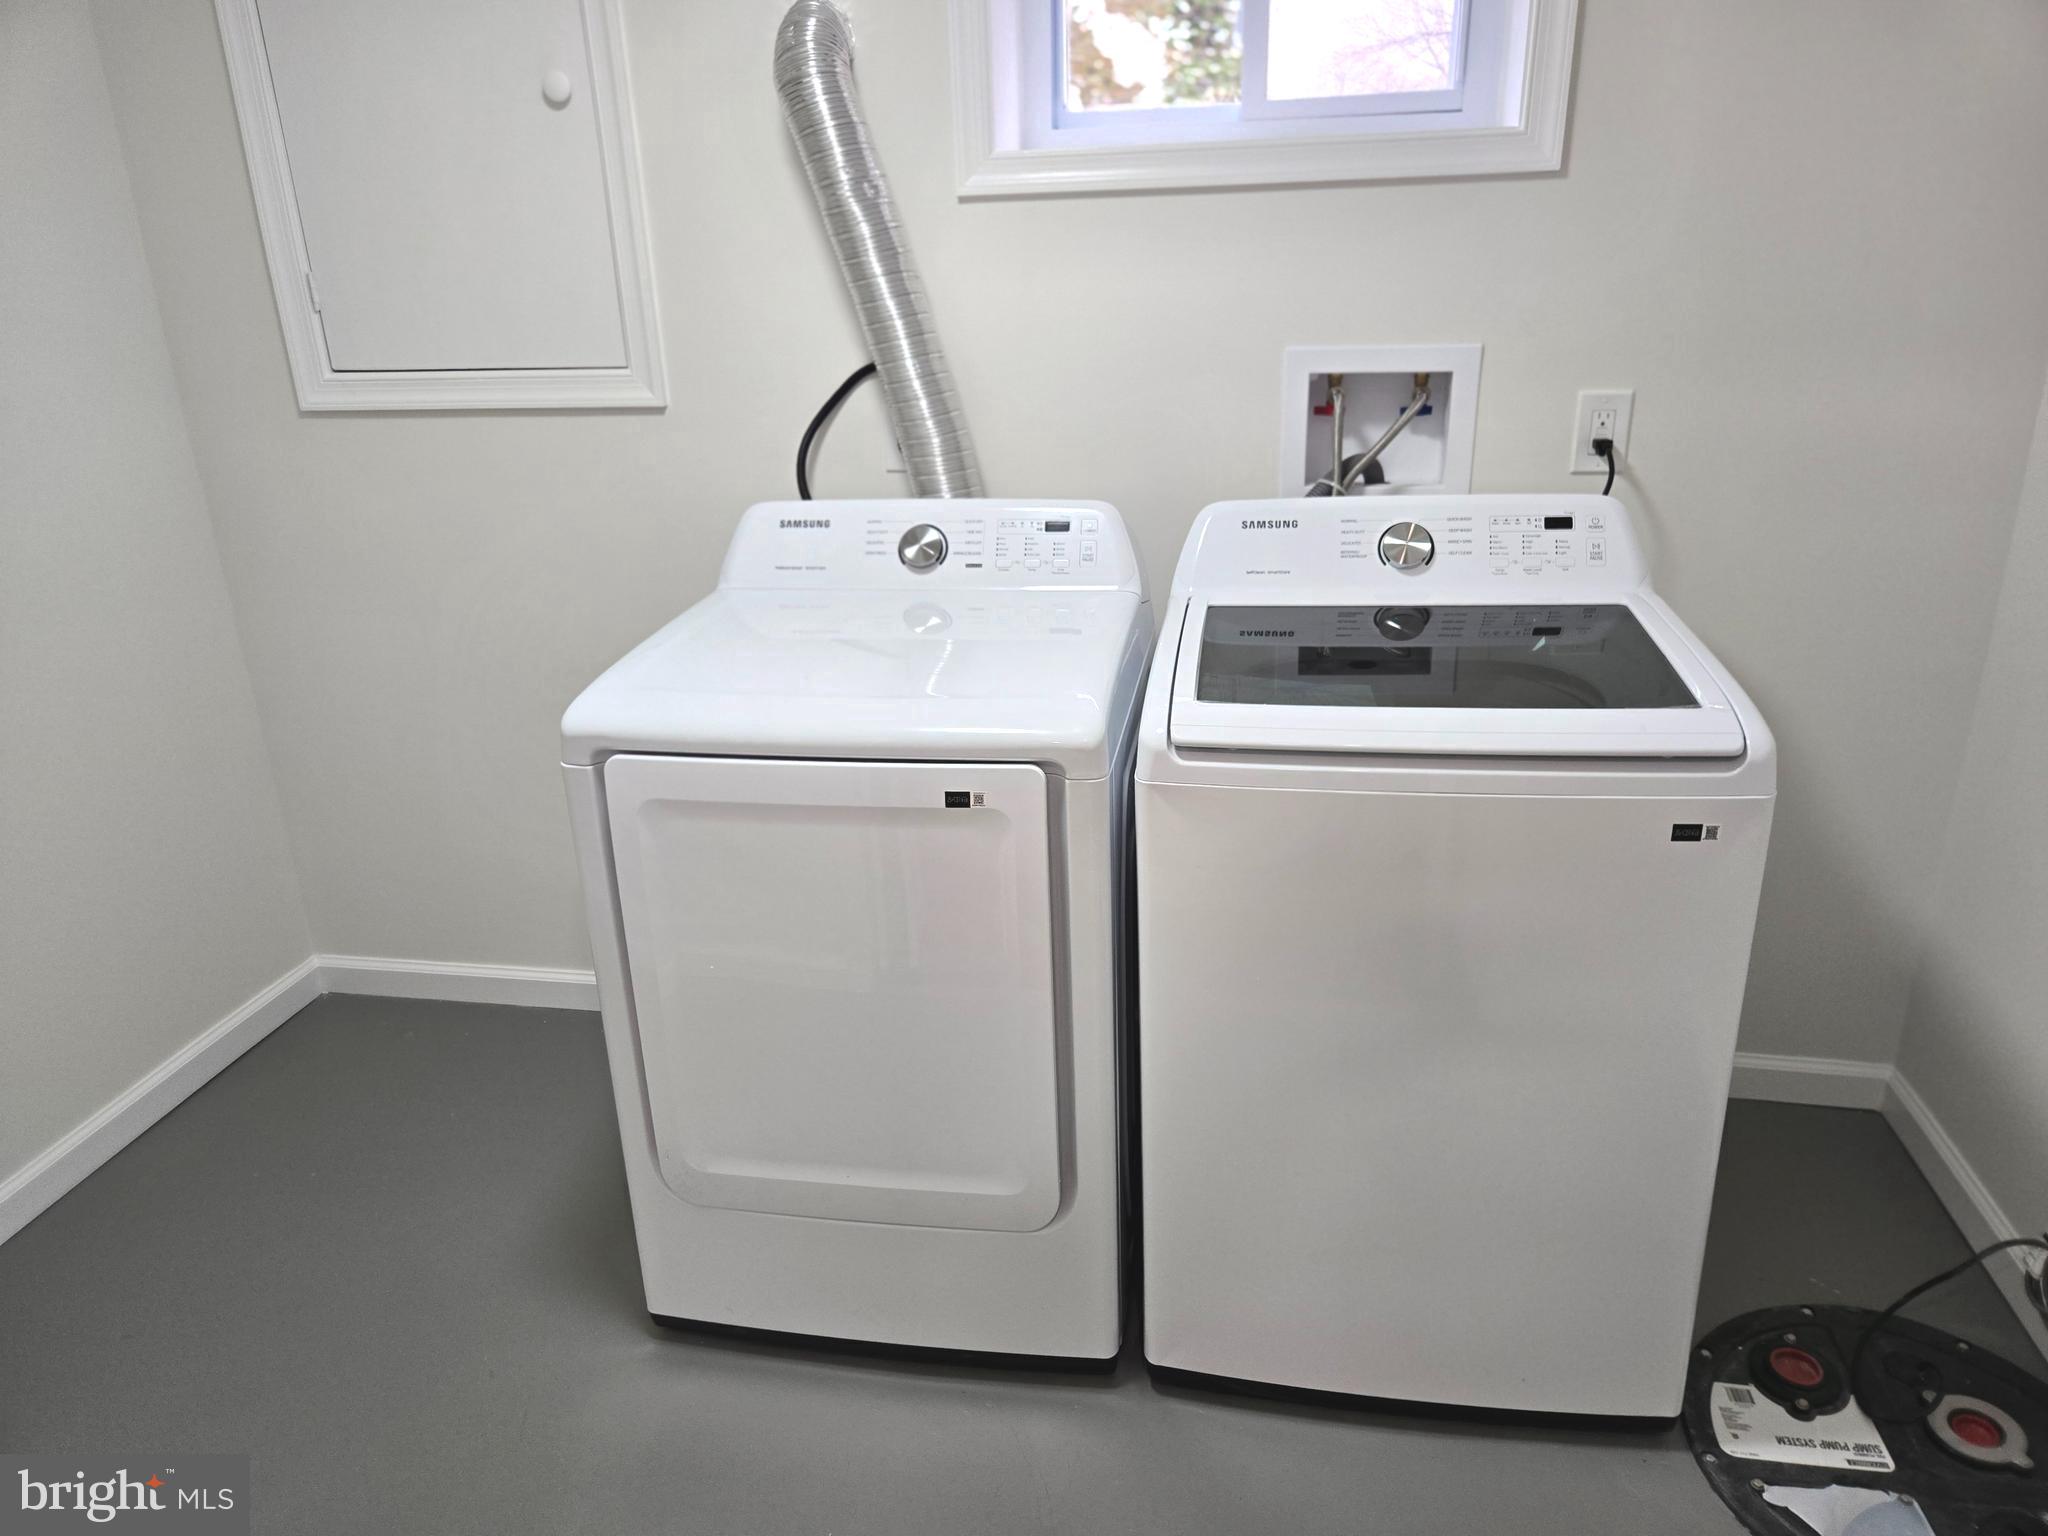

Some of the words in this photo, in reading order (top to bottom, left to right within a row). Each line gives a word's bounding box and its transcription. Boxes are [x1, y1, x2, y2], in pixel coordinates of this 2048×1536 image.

[779, 519, 831, 528] SAMSUNG
[1241, 520, 1299, 529] SAMSUNG
[1774, 1435, 1817, 1449] SYSTEM
[1819, 1440, 1851, 1452] PUMP
[1852, 1443, 1883, 1454] SUMP
